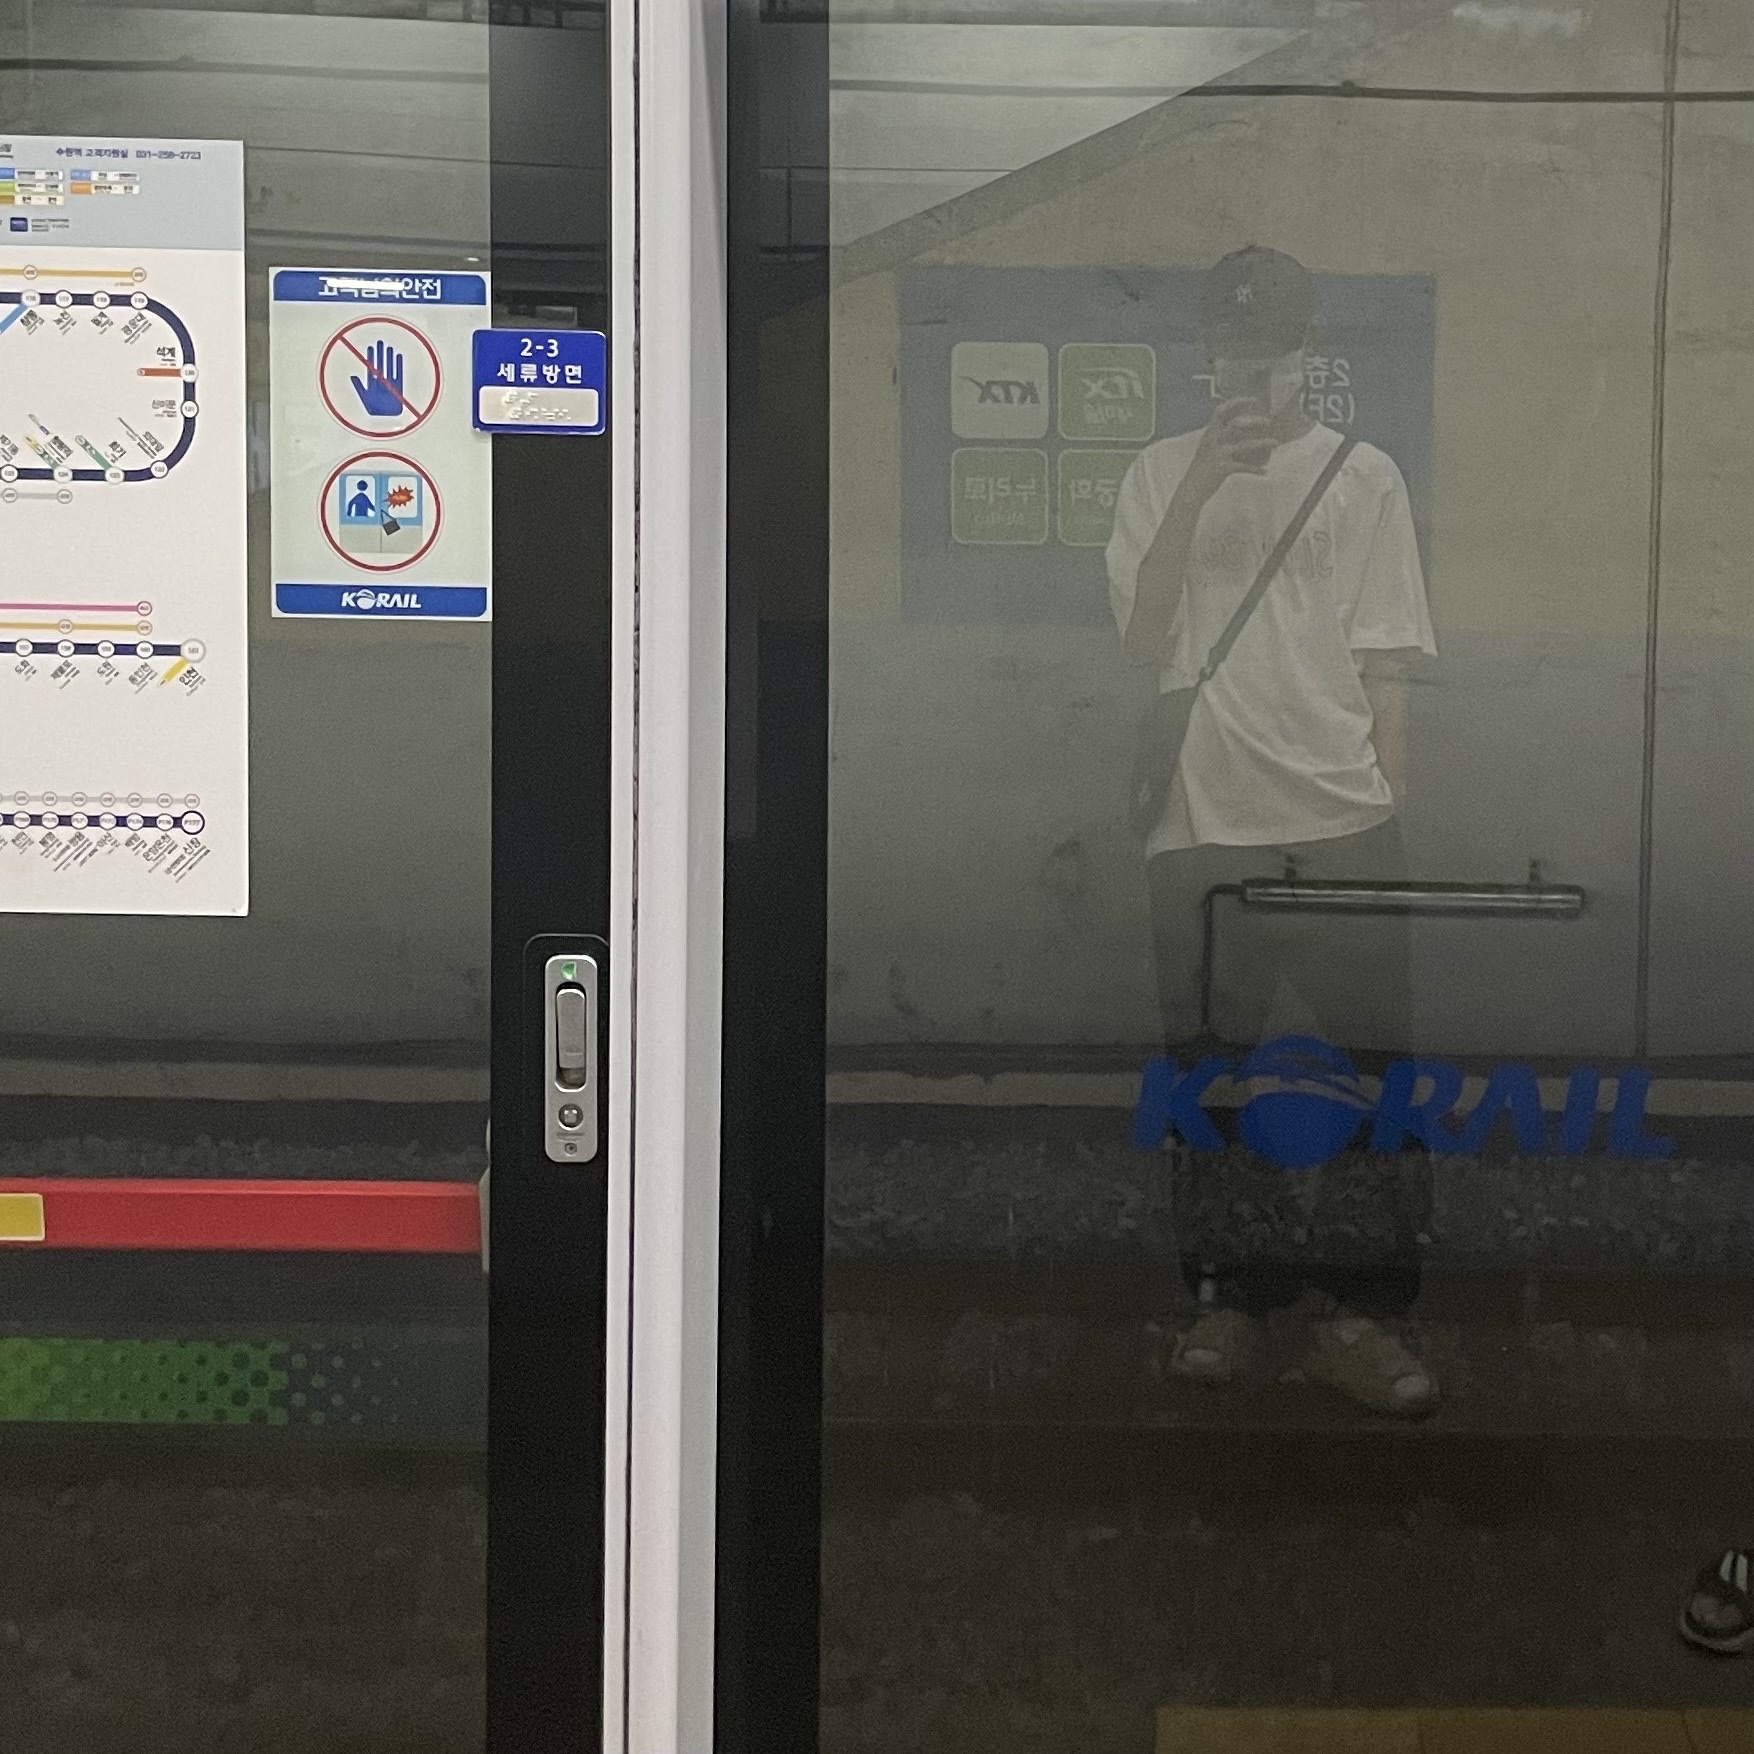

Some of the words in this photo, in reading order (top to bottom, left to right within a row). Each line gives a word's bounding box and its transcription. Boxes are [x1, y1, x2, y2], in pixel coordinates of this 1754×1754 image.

[520, 338, 560, 358] 2-3
[496, 362, 583, 385] 세류방면
[341, 589, 422, 611] KORAIL
[1132, 1032, 1677, 1172] KORAIL
